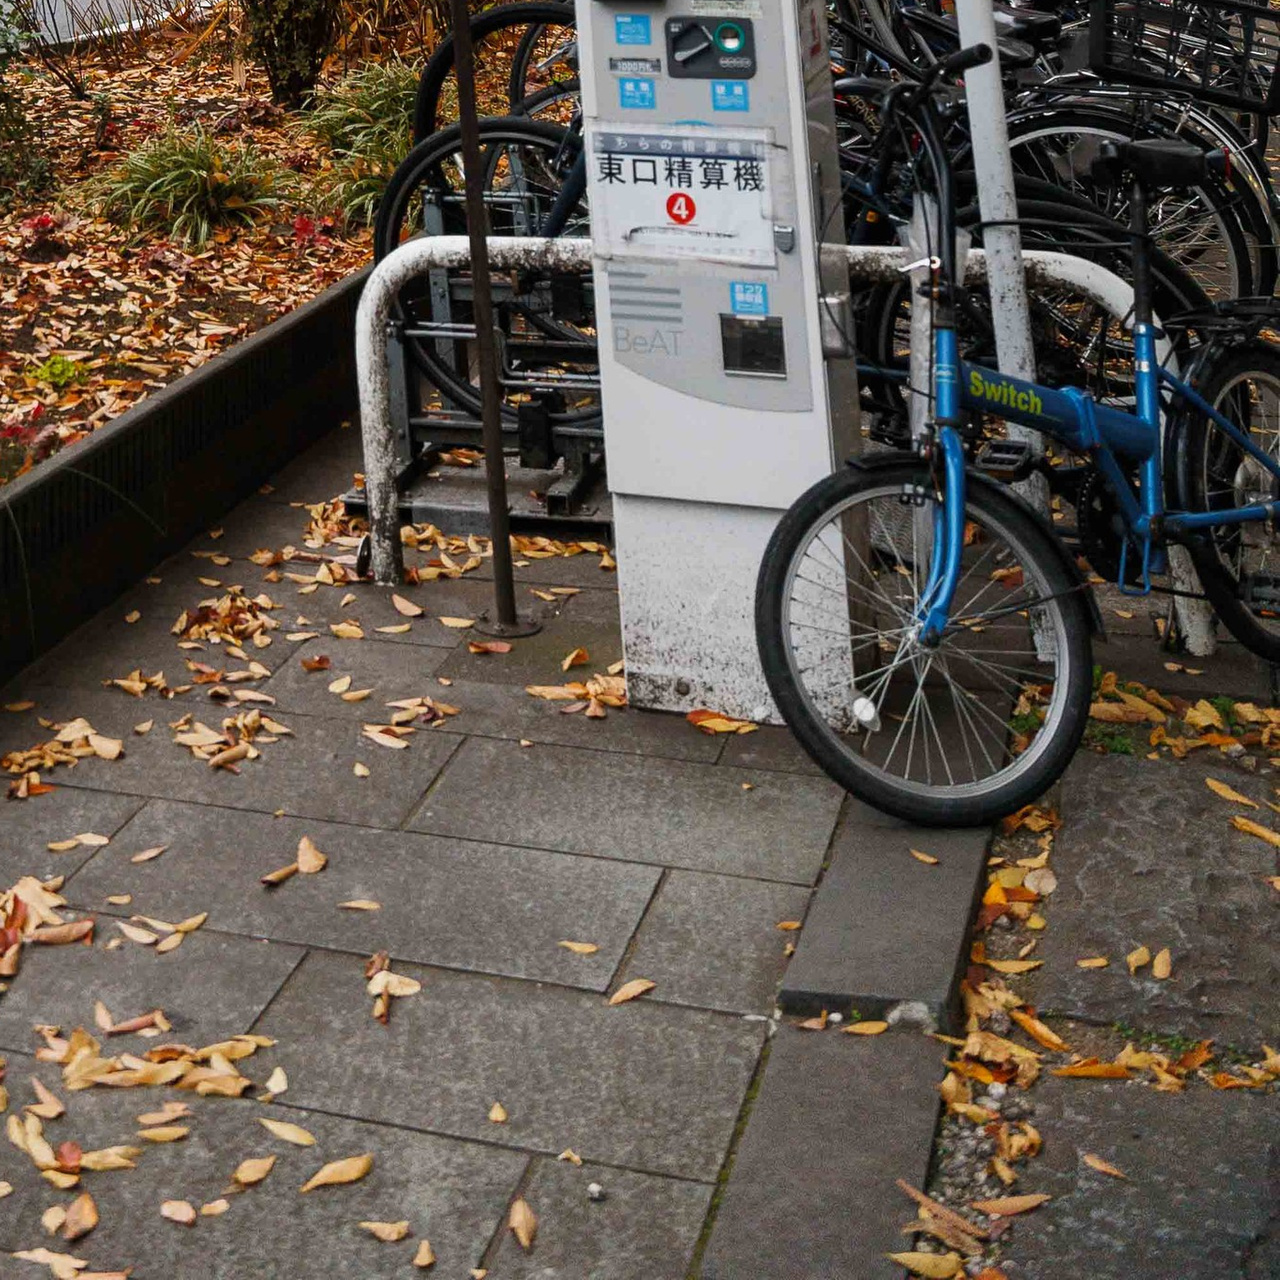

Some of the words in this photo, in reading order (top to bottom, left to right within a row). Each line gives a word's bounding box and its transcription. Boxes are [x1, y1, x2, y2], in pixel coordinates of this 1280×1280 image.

[596, 154, 766, 192] 東口精算機
[672, 196, 689, 220] 4
[614, 326, 684, 356] BeAT
[969, 370, 1043, 416] Switch
